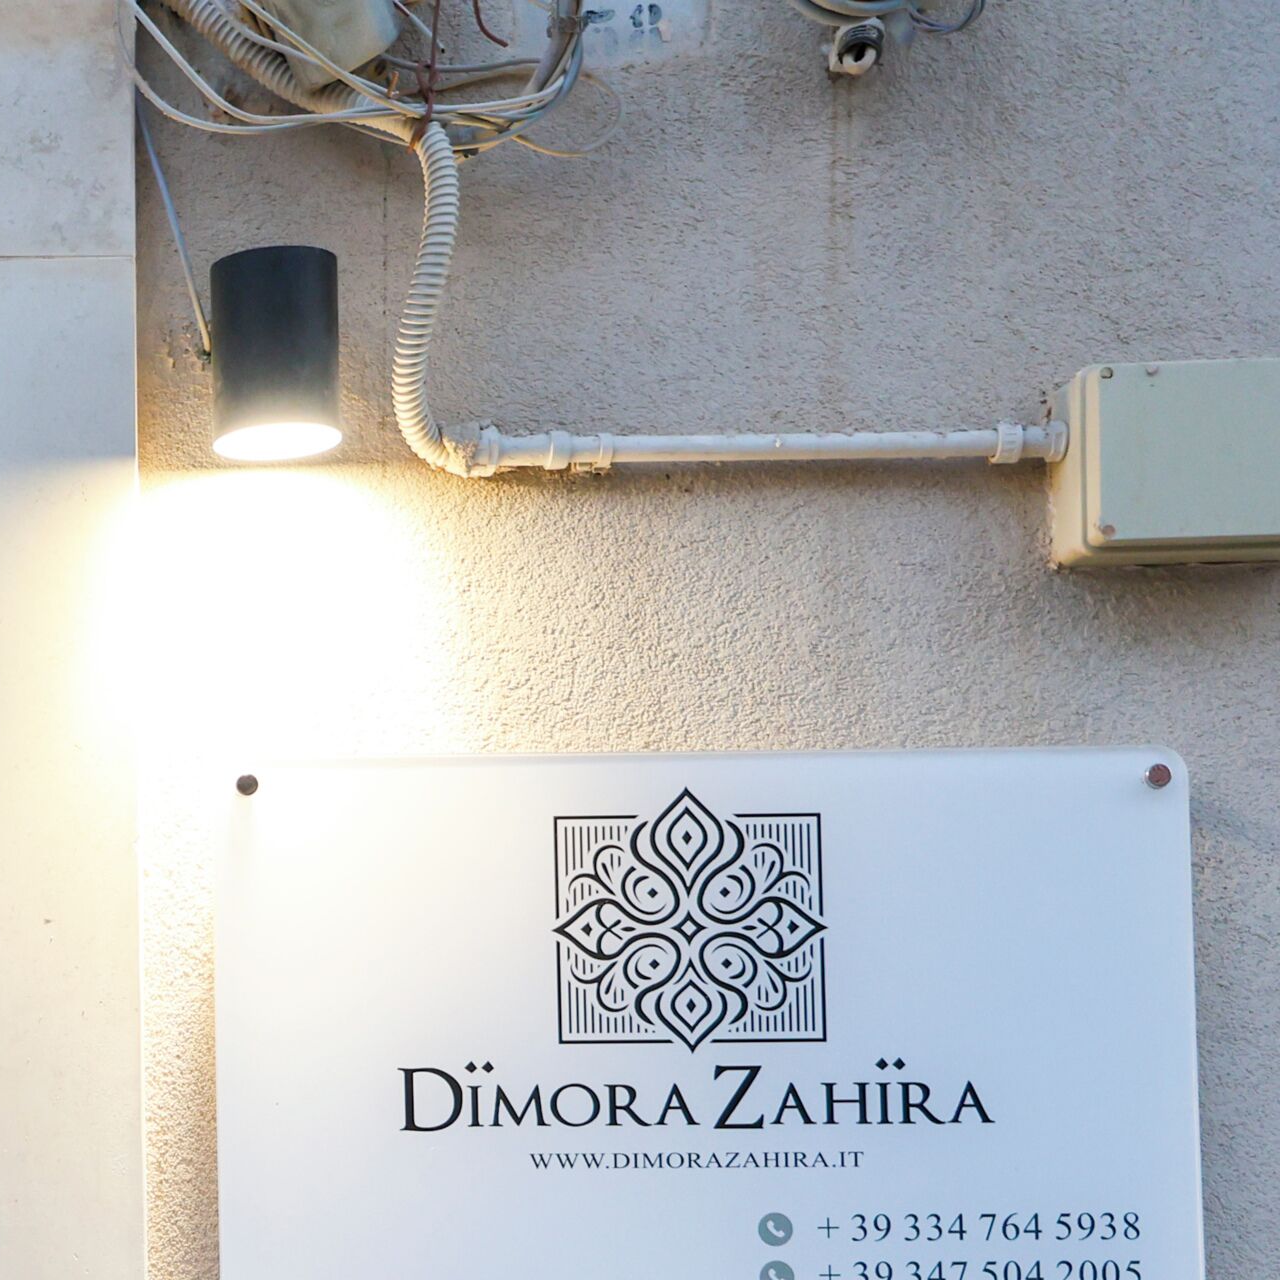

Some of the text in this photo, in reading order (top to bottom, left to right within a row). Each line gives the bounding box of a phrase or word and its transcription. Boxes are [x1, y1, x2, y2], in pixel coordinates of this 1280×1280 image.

[529, 1150, 865, 1170] WWW.DIMORAZAHIRA.IT
[851, 1213, 892, 1242] 39
[903, 1212, 968, 1242] 334
[978, 1212, 1044, 1242] 764
[1055, 1211, 1141, 1241] 5938
